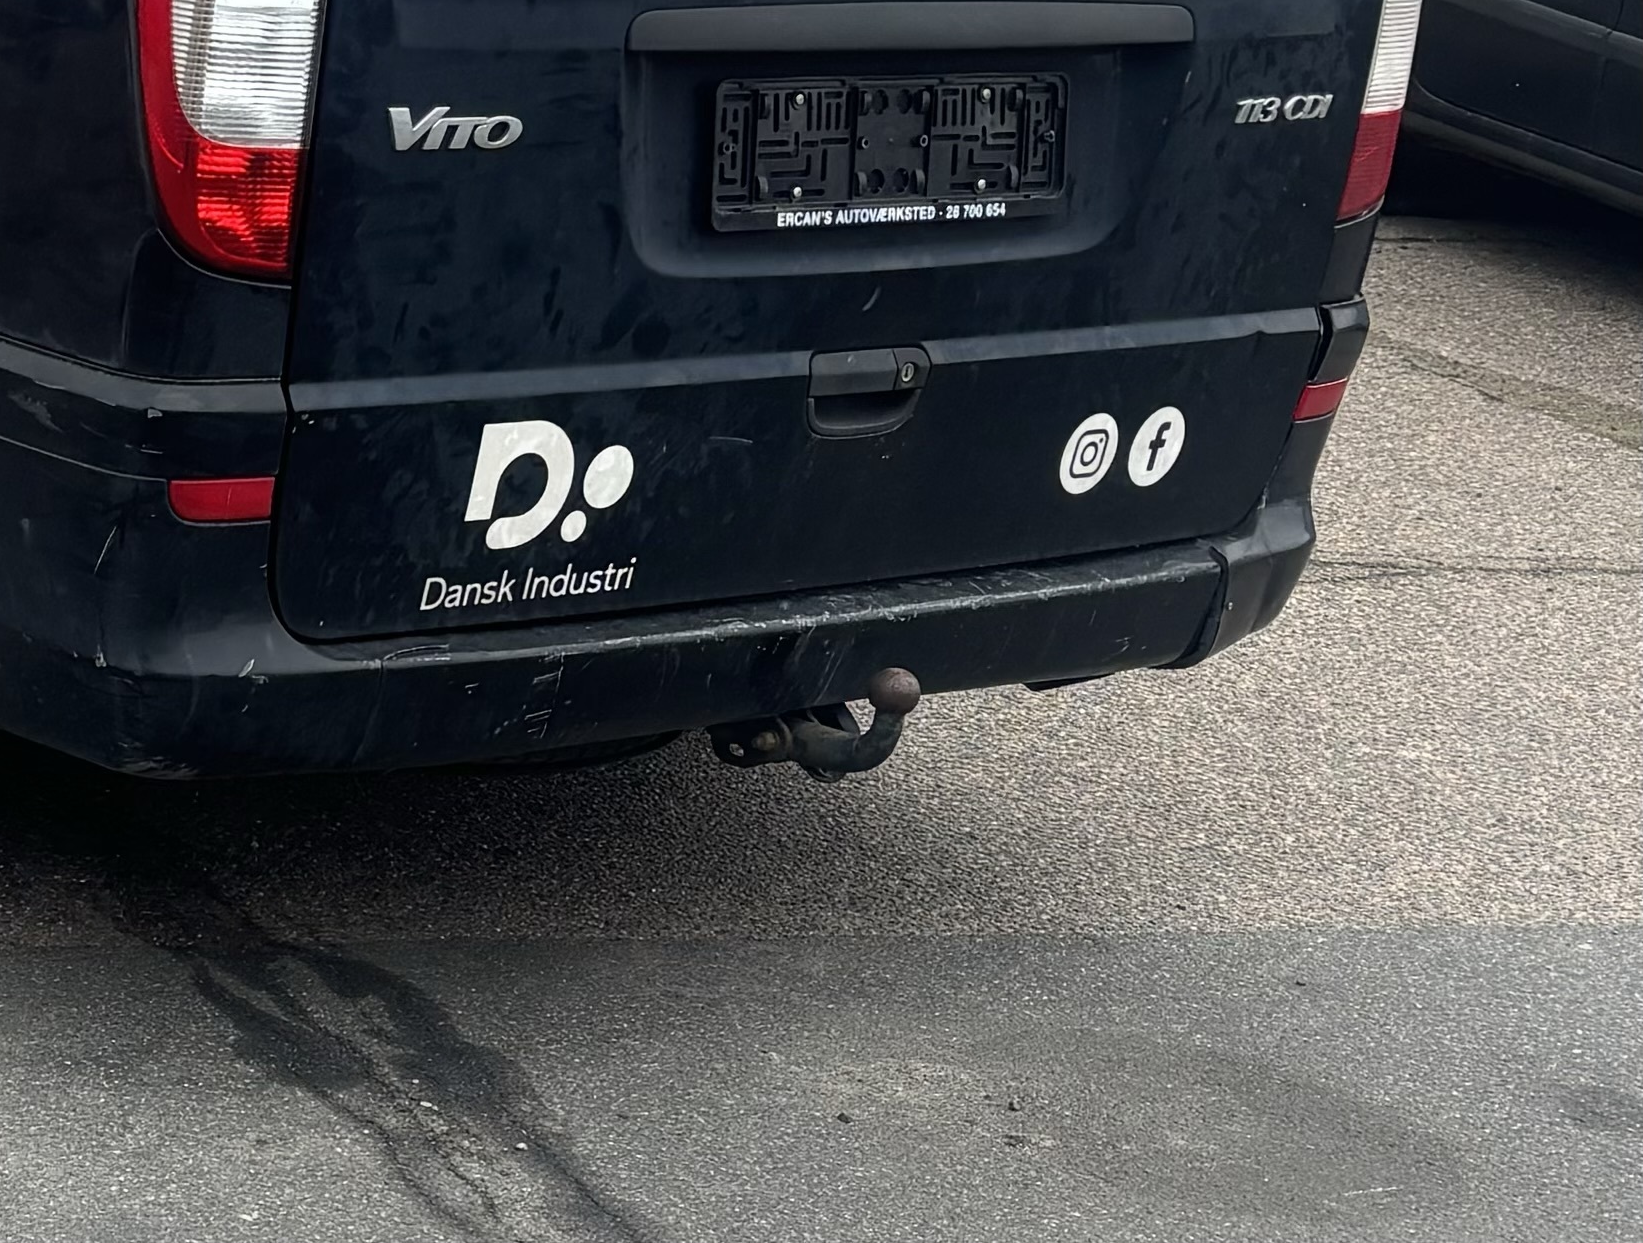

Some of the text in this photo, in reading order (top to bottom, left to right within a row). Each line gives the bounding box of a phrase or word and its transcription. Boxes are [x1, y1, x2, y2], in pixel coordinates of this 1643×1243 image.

[1234, 94, 1334, 124] 113 CDI
[776, 210, 833, 228] ERCAN'S
[835, 205, 936, 225] AUTOVÆRKSTED
[963, 203, 984, 219] 700
[985, 202, 1007, 218] 654
[419, 556, 637, 611] Dansk Industri
